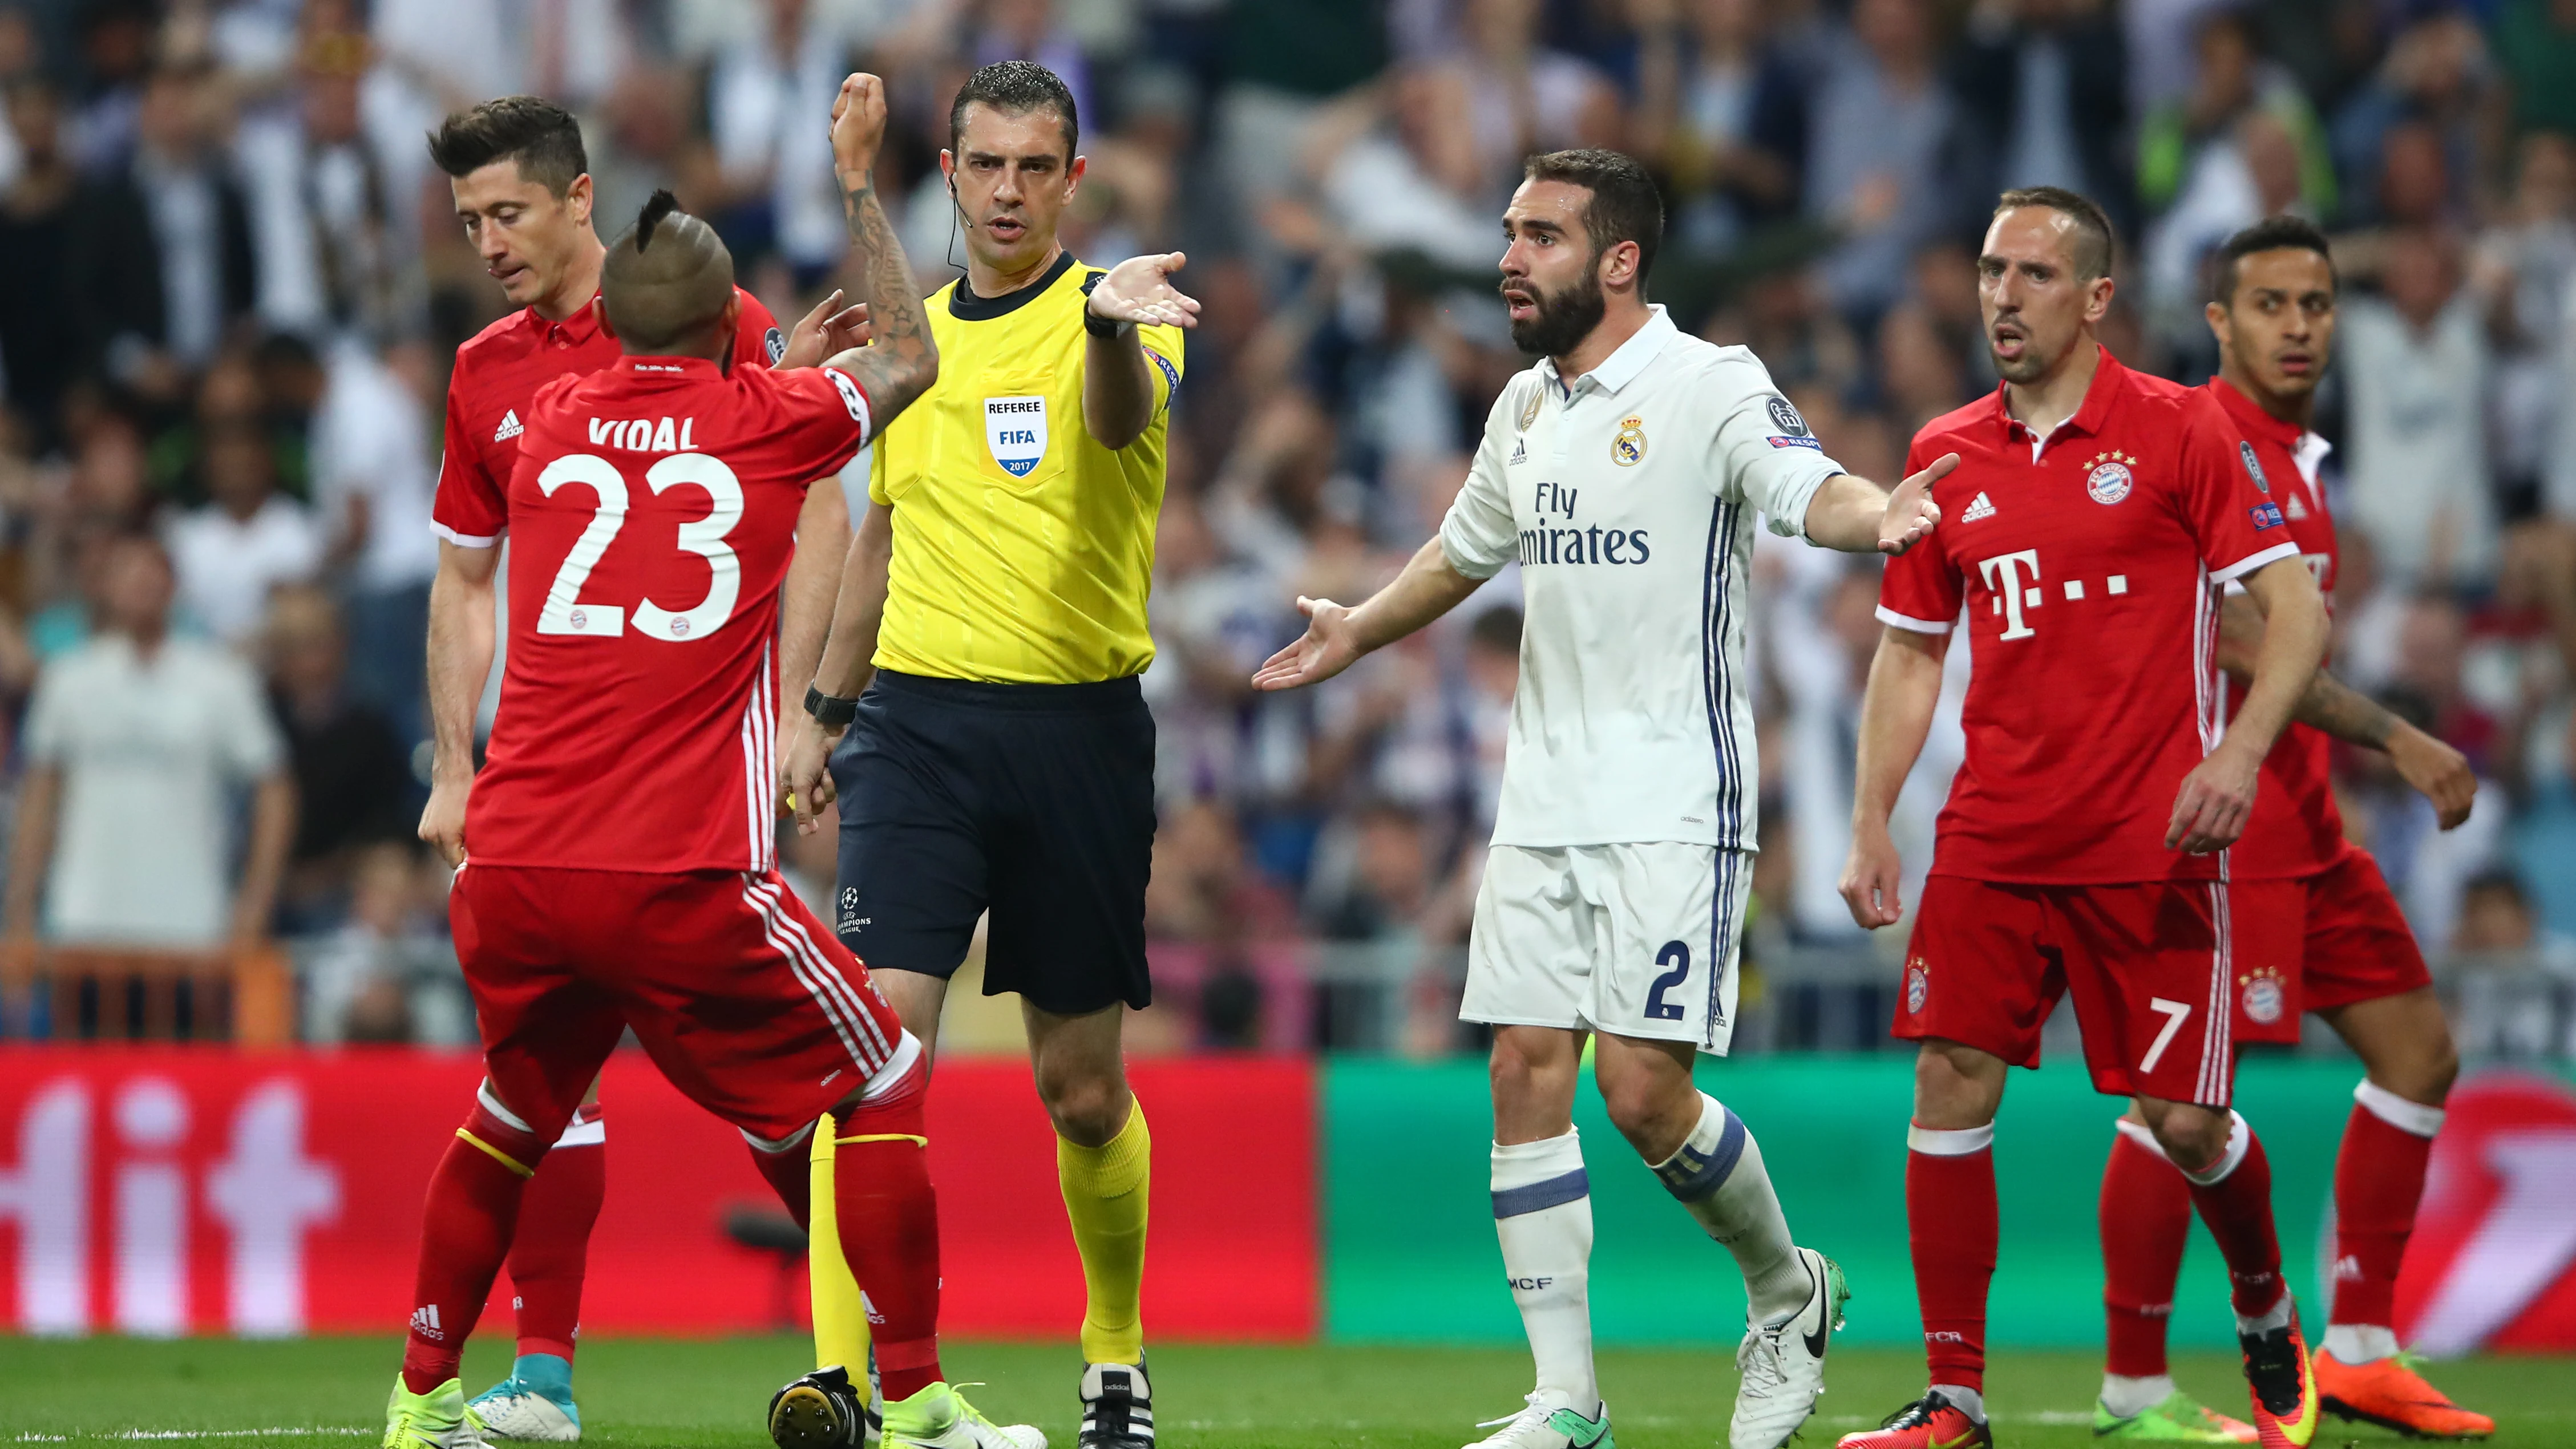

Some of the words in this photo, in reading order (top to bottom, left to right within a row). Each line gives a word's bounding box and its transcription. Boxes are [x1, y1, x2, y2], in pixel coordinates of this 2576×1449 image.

[989, 402, 1041, 414] REFEREE
[1783, 416, 1799, 427] 11
[495, 424, 524, 443] adidas
[588, 416, 699, 452] VIDAL
[1000, 430, 1036, 444] FIFA
[1009, 462, 1030, 471] 2017
[1509, 455, 1527, 466] adidas
[2098, 465, 2128, 479] BAYERN
[1535, 483, 1578, 520] Fly
[1962, 506, 1996, 524] adidas
[536, 454, 745, 642] 23
[1519, 517, 1650, 566] mirates
[840, 926, 860, 934] LEAGUE
[1643, 940, 1691, 1021] 2
[2139, 997, 2191, 1074] 7
[410, 1317, 444, 1340] adidas
